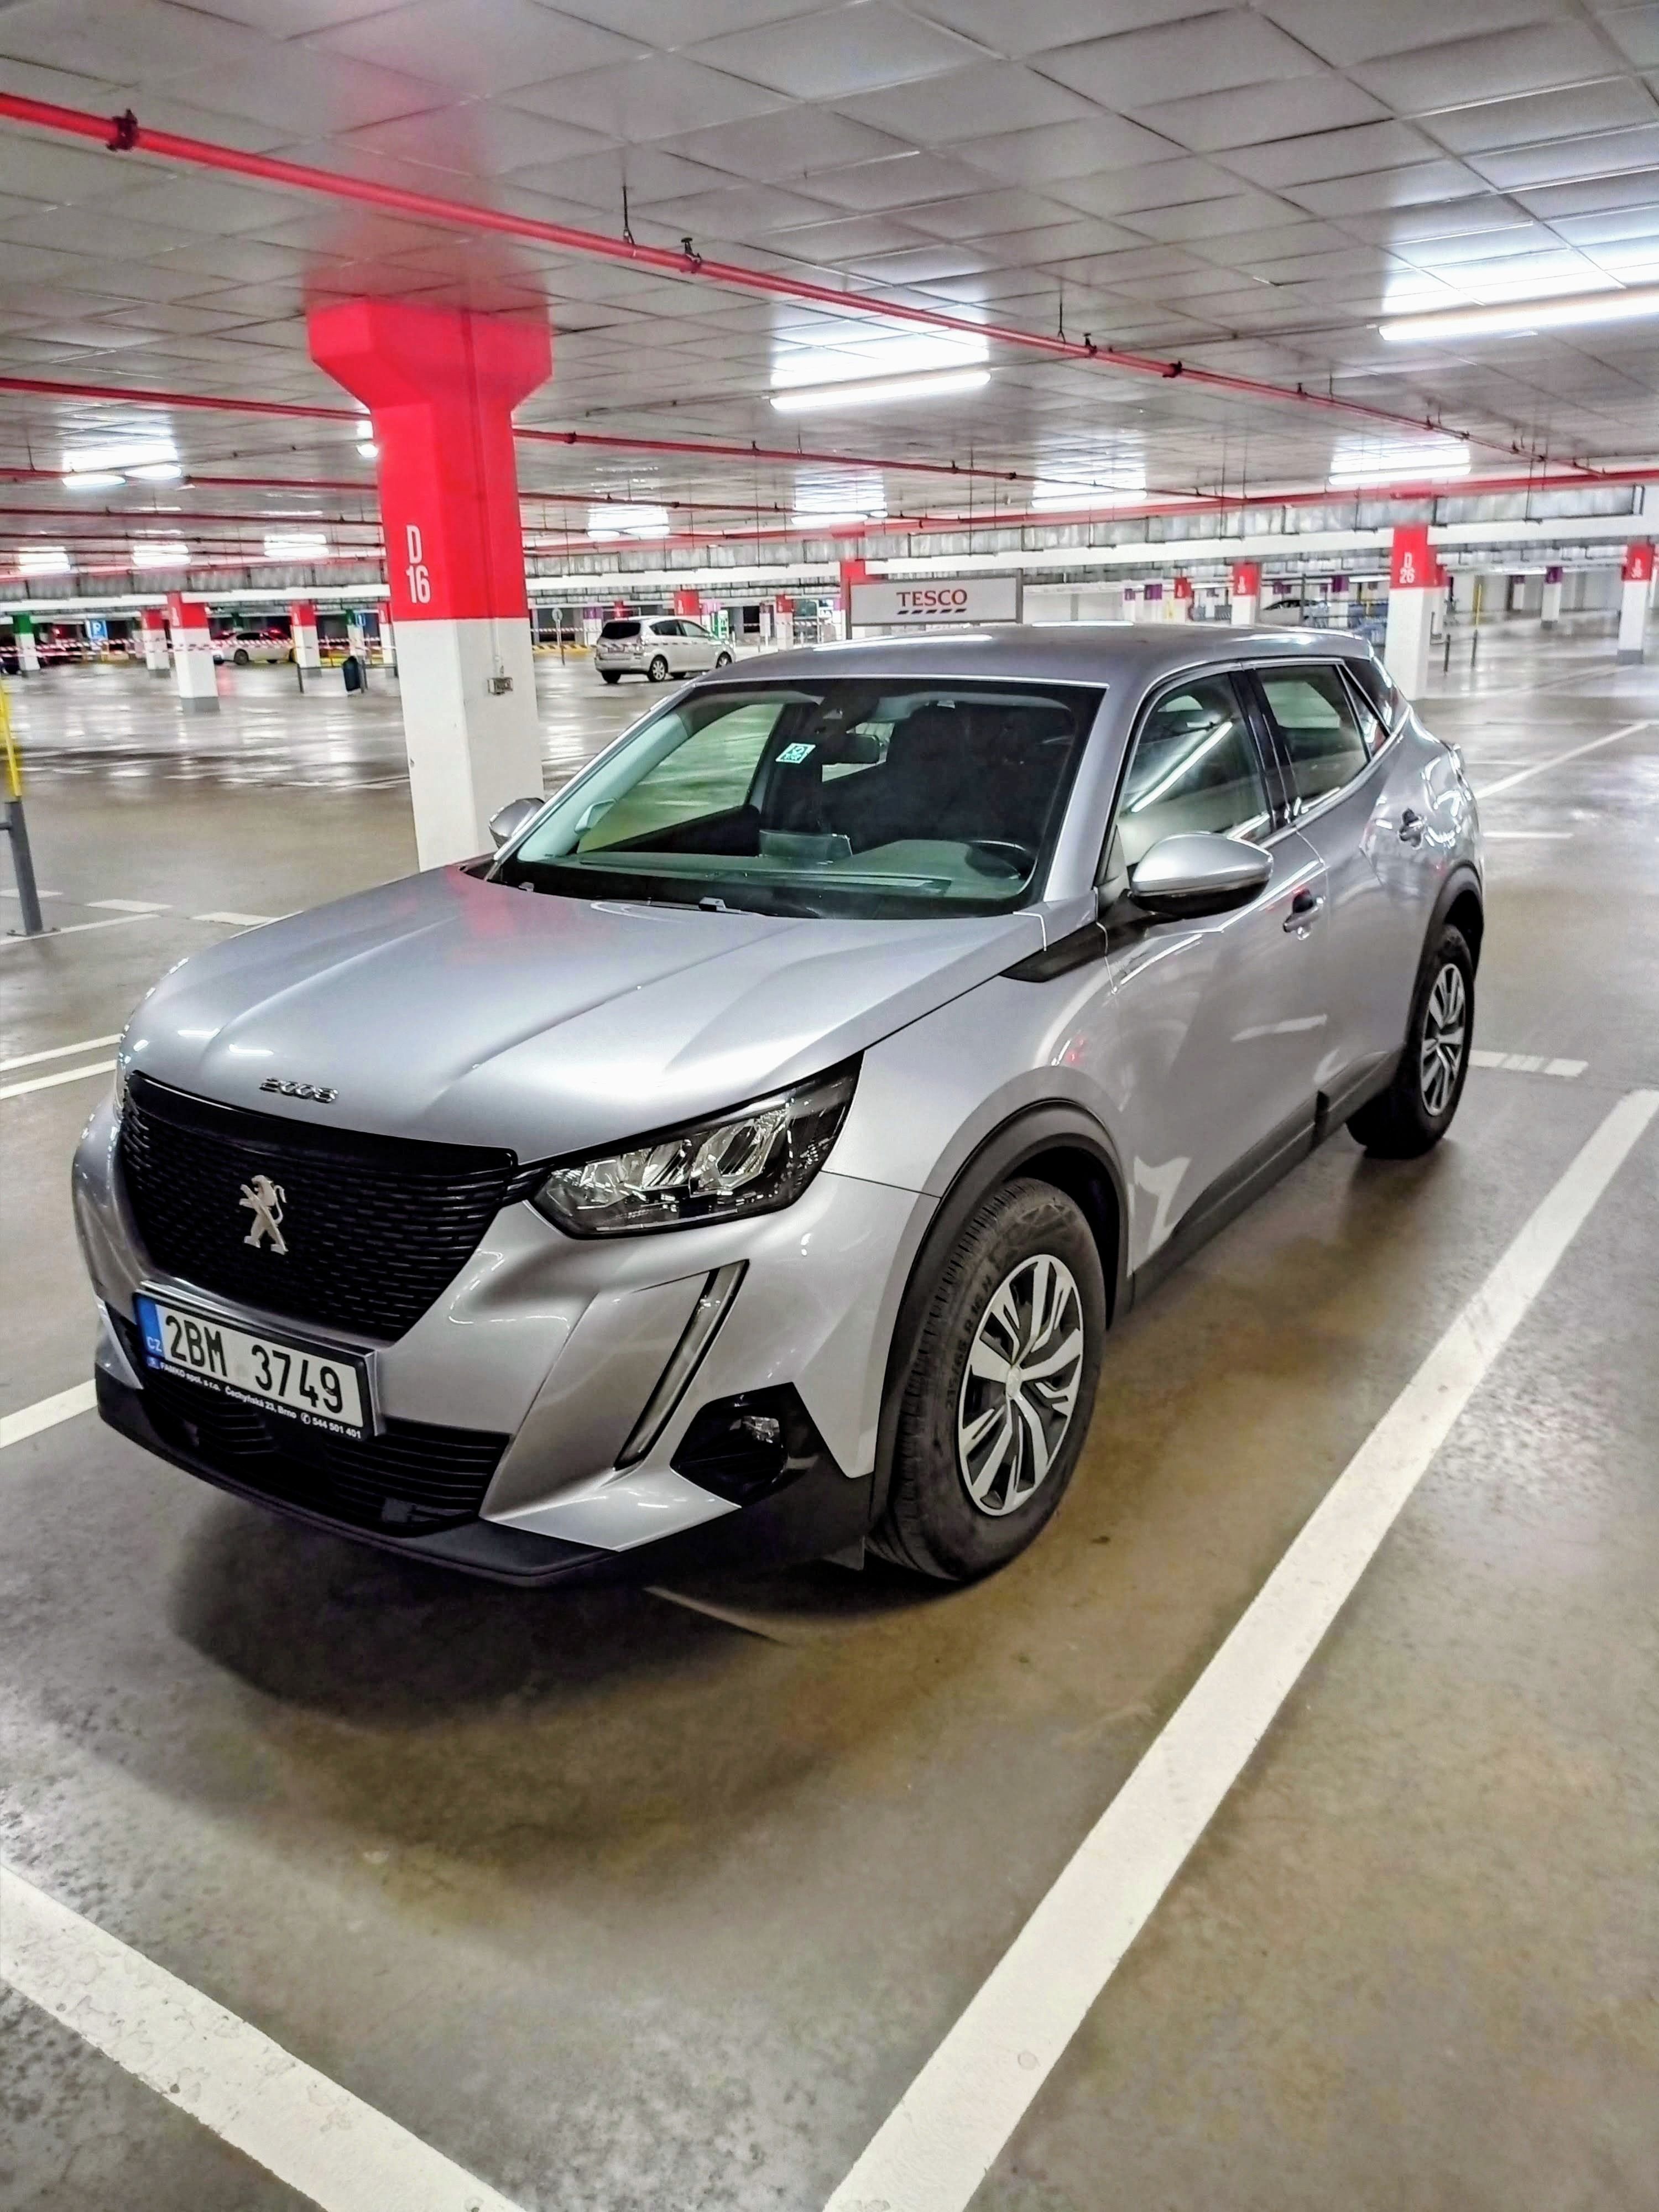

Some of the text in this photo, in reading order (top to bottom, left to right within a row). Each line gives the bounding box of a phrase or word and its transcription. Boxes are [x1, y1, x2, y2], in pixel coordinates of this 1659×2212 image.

[406, 524, 422, 564] D
[1404, 551, 1413, 568] D
[405, 565, 431, 604] 16
[1399, 568, 1415, 584] 26
[895, 589, 968, 607] TESCO
[93, 623, 102, 635] P
[258, 1076, 340, 1104] 2008
[147, 1337, 162, 1353] CZ
[166, 1315, 343, 1414] 2BM 3749
[277, 1405, 297, 1419] Brno
[311, 1417, 327, 1429] 544
[328, 1422, 344, 1434] 501
[346, 1428, 362, 1439] 401
